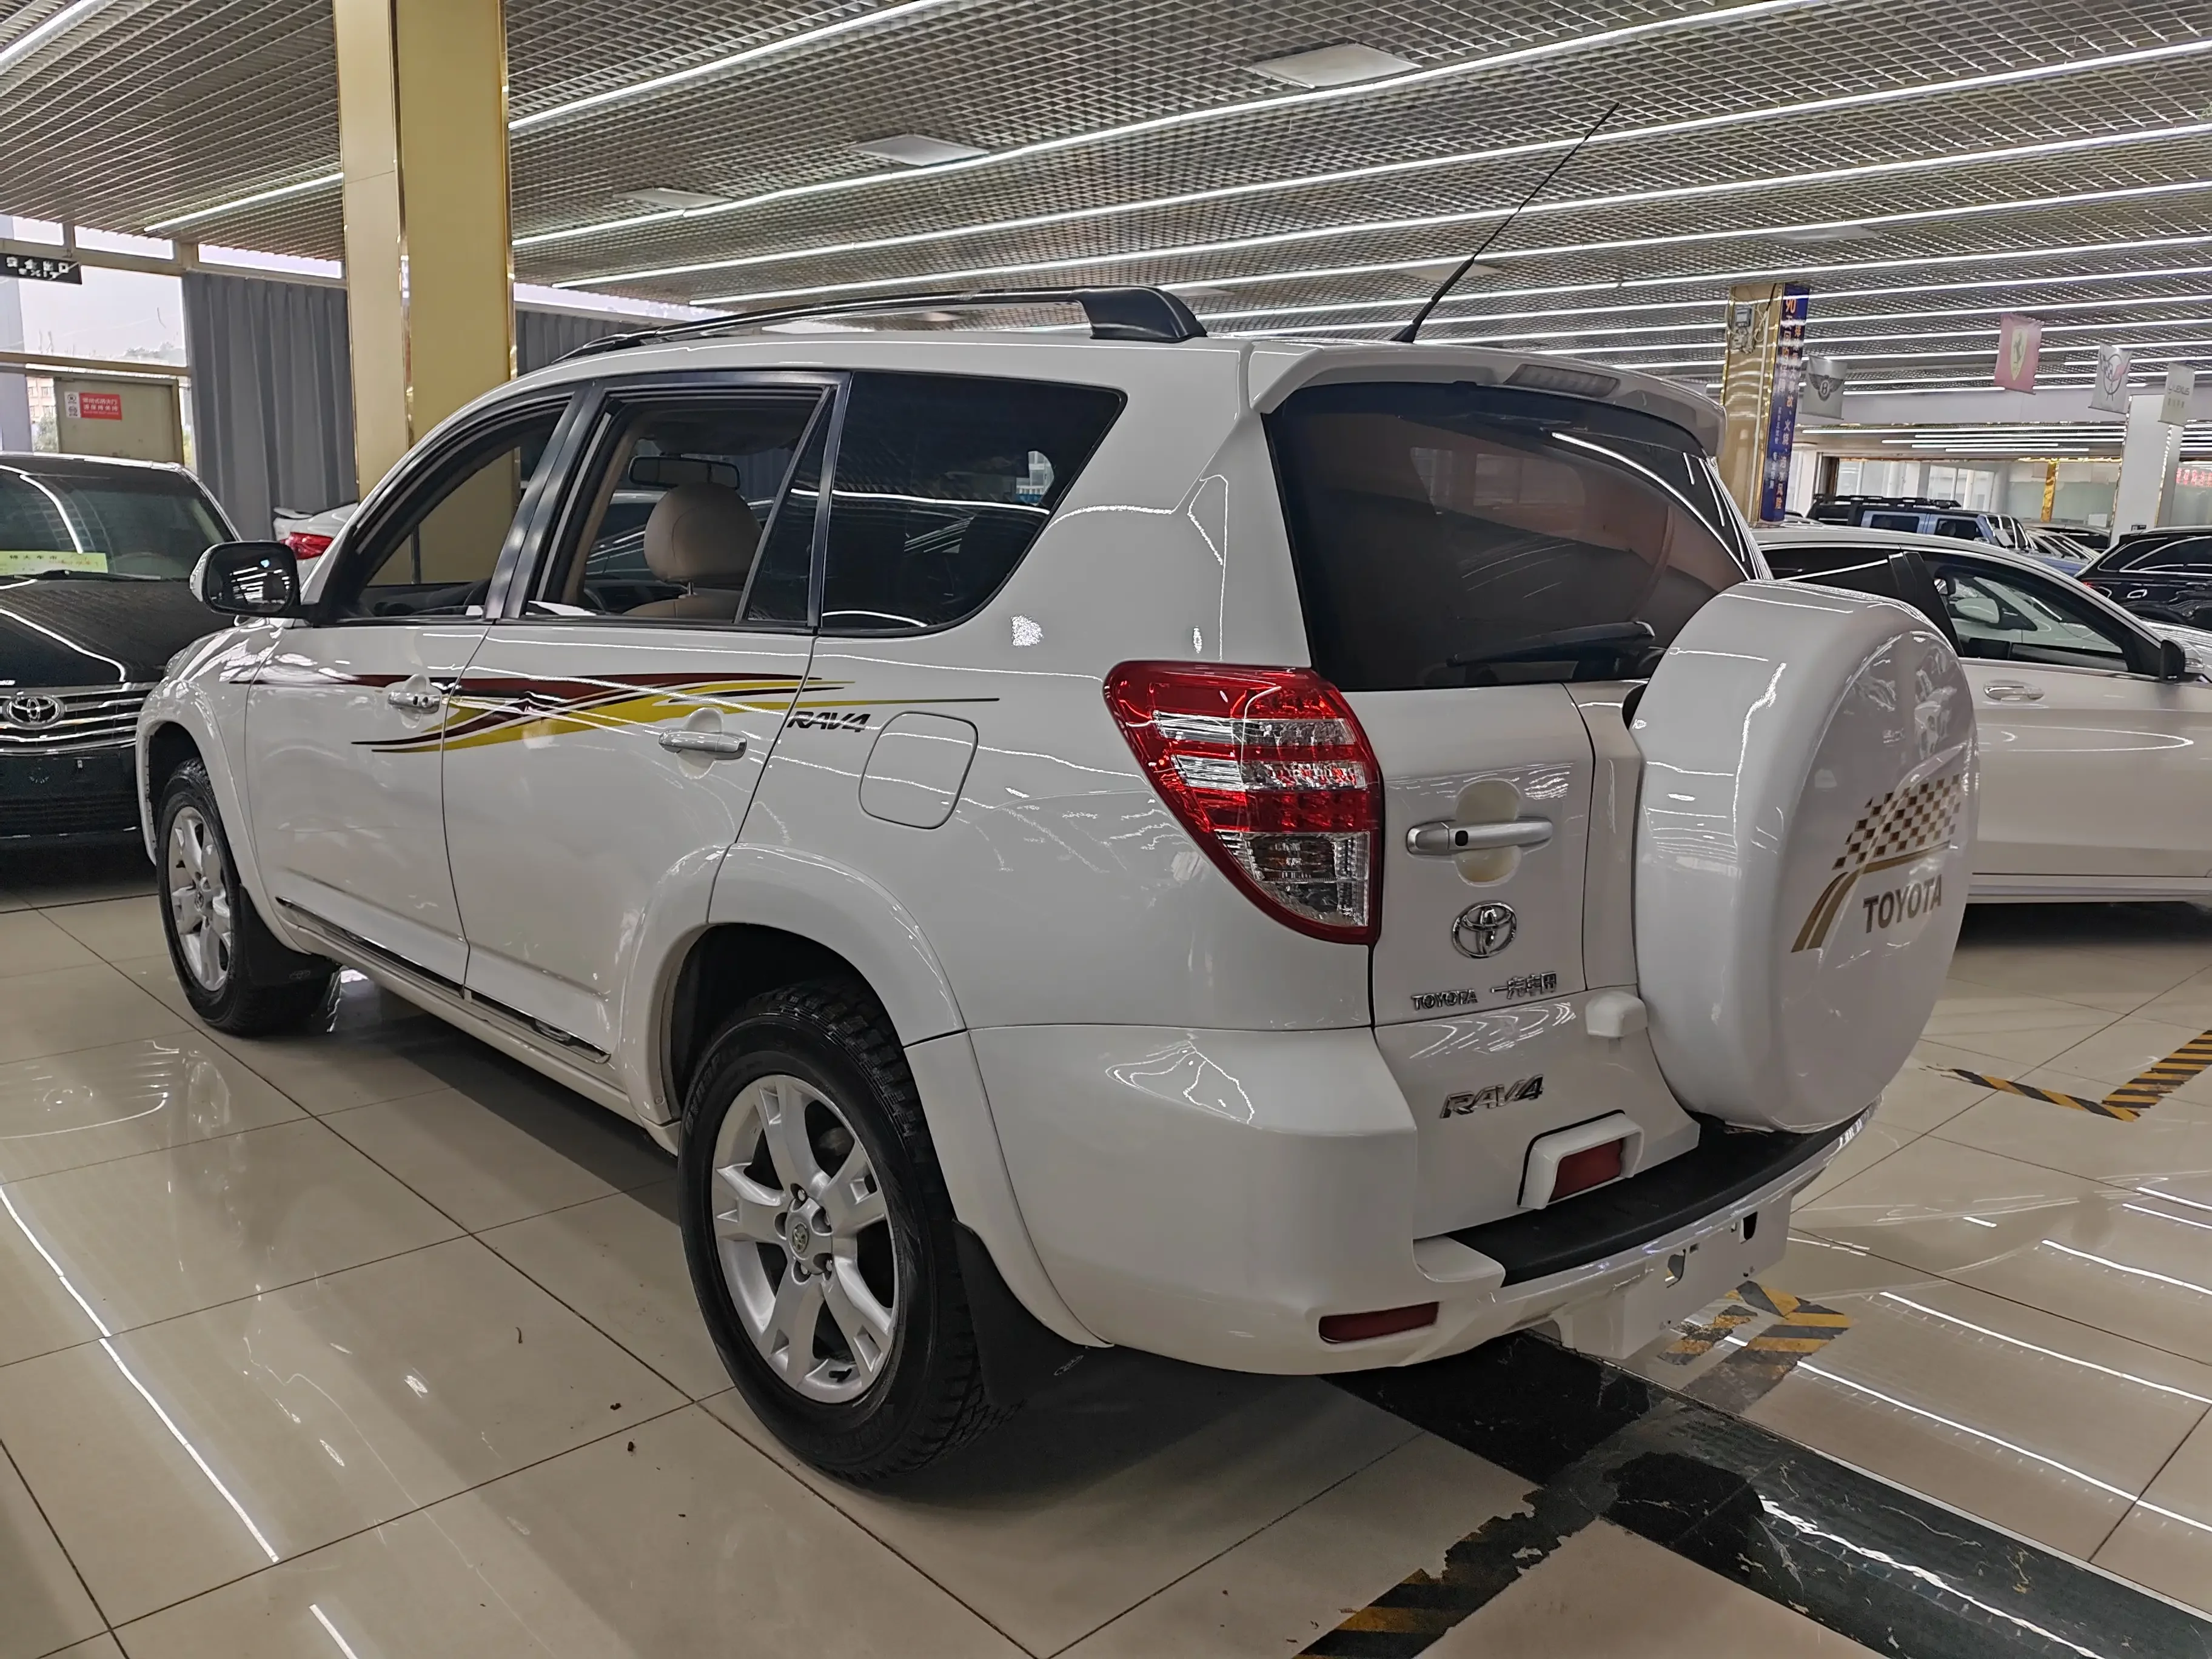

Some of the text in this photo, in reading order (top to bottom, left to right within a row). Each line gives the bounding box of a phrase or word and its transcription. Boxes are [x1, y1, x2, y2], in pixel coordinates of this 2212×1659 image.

[7, 256, 69, 273] 安全出口
[786, 711, 871, 732] RAV4
[1863, 874, 1942, 933] TOYOTA
[1411, 989, 1478, 1010] TOYOTA
[1439, 1074, 1544, 1118] RAV4
